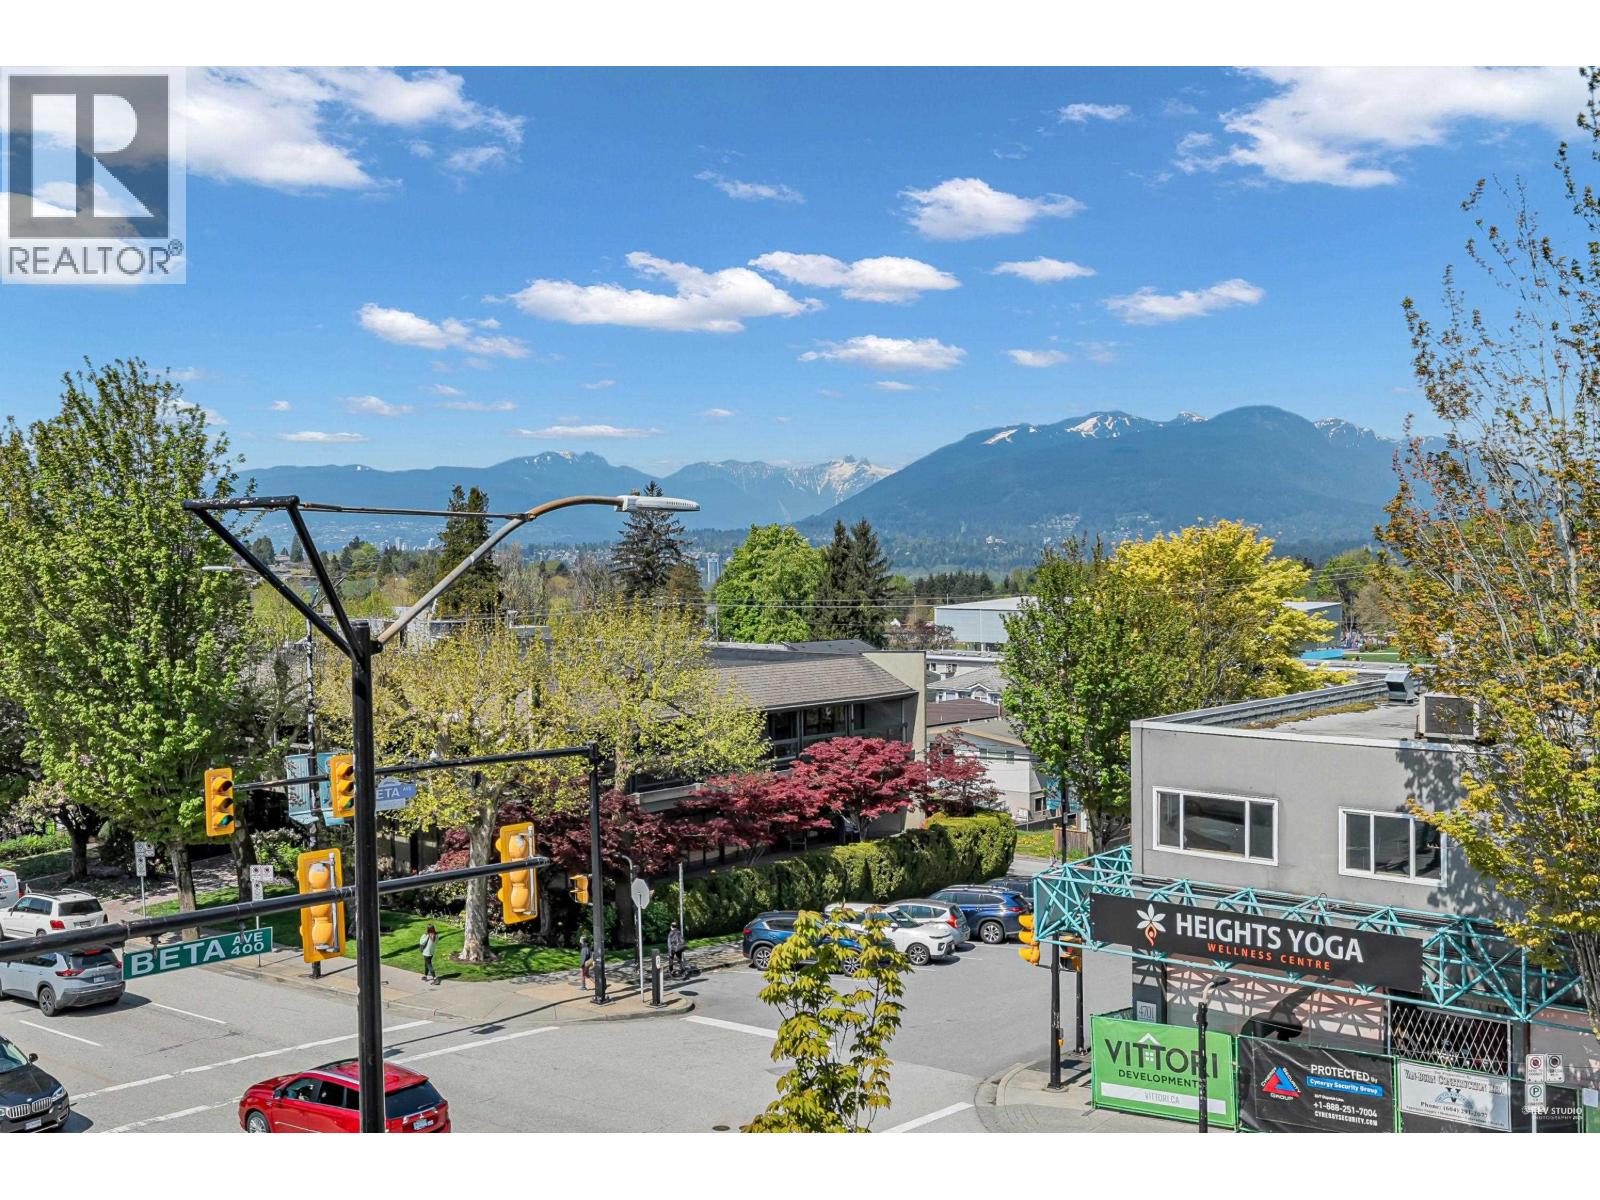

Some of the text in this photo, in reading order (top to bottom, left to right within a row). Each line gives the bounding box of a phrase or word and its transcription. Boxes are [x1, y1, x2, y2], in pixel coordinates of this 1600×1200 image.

[376, 786, 400, 800] ETA
[232, 931, 264, 946] AVE
[1176, 913, 1364, 963] HEIGHTS YOGA
[231, 941, 265, 956] 400
[1207, 942, 1331, 971] WELLNESS CENTRE
[131, 939, 226, 976] BETA
[1310, 1063, 1370, 1083] PROTECTED
[1310, 1078, 1378, 1095] Cynergy Security Group
[1313, 1101, 1378, 1118] +1-888-251-7004
[1314, 1110, 1378, 1127] CYNERGYSECURITY.COM
